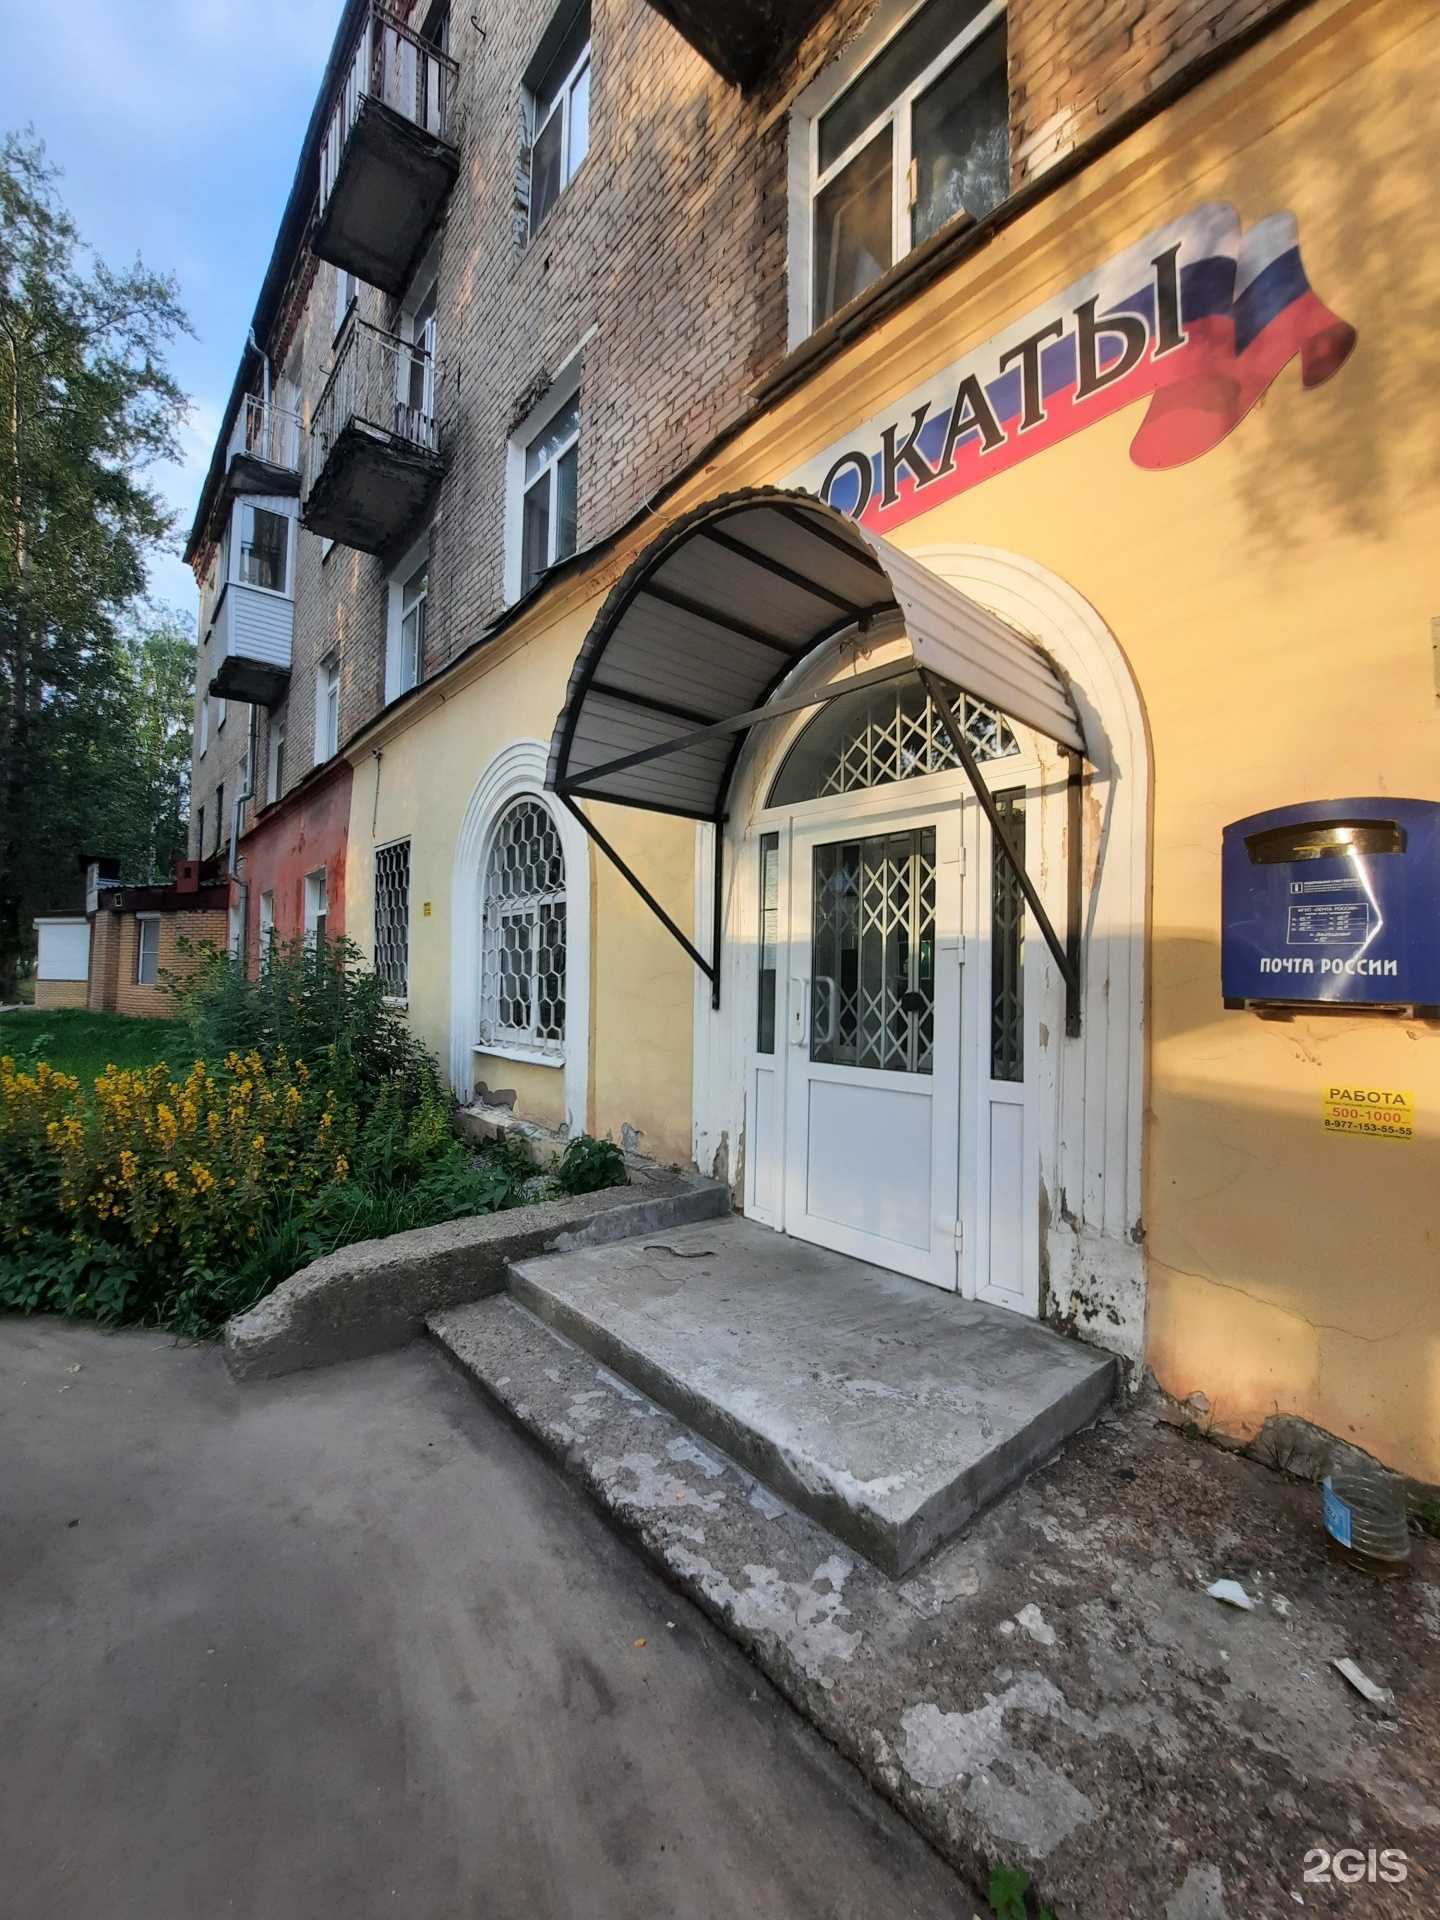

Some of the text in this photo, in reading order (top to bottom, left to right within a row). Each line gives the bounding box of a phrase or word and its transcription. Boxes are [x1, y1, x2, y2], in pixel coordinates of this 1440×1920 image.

[1260, 958, 1398, 976] ПОЧТА РОССИИ
[1329, 1088, 1406, 1105] РАБОТА
